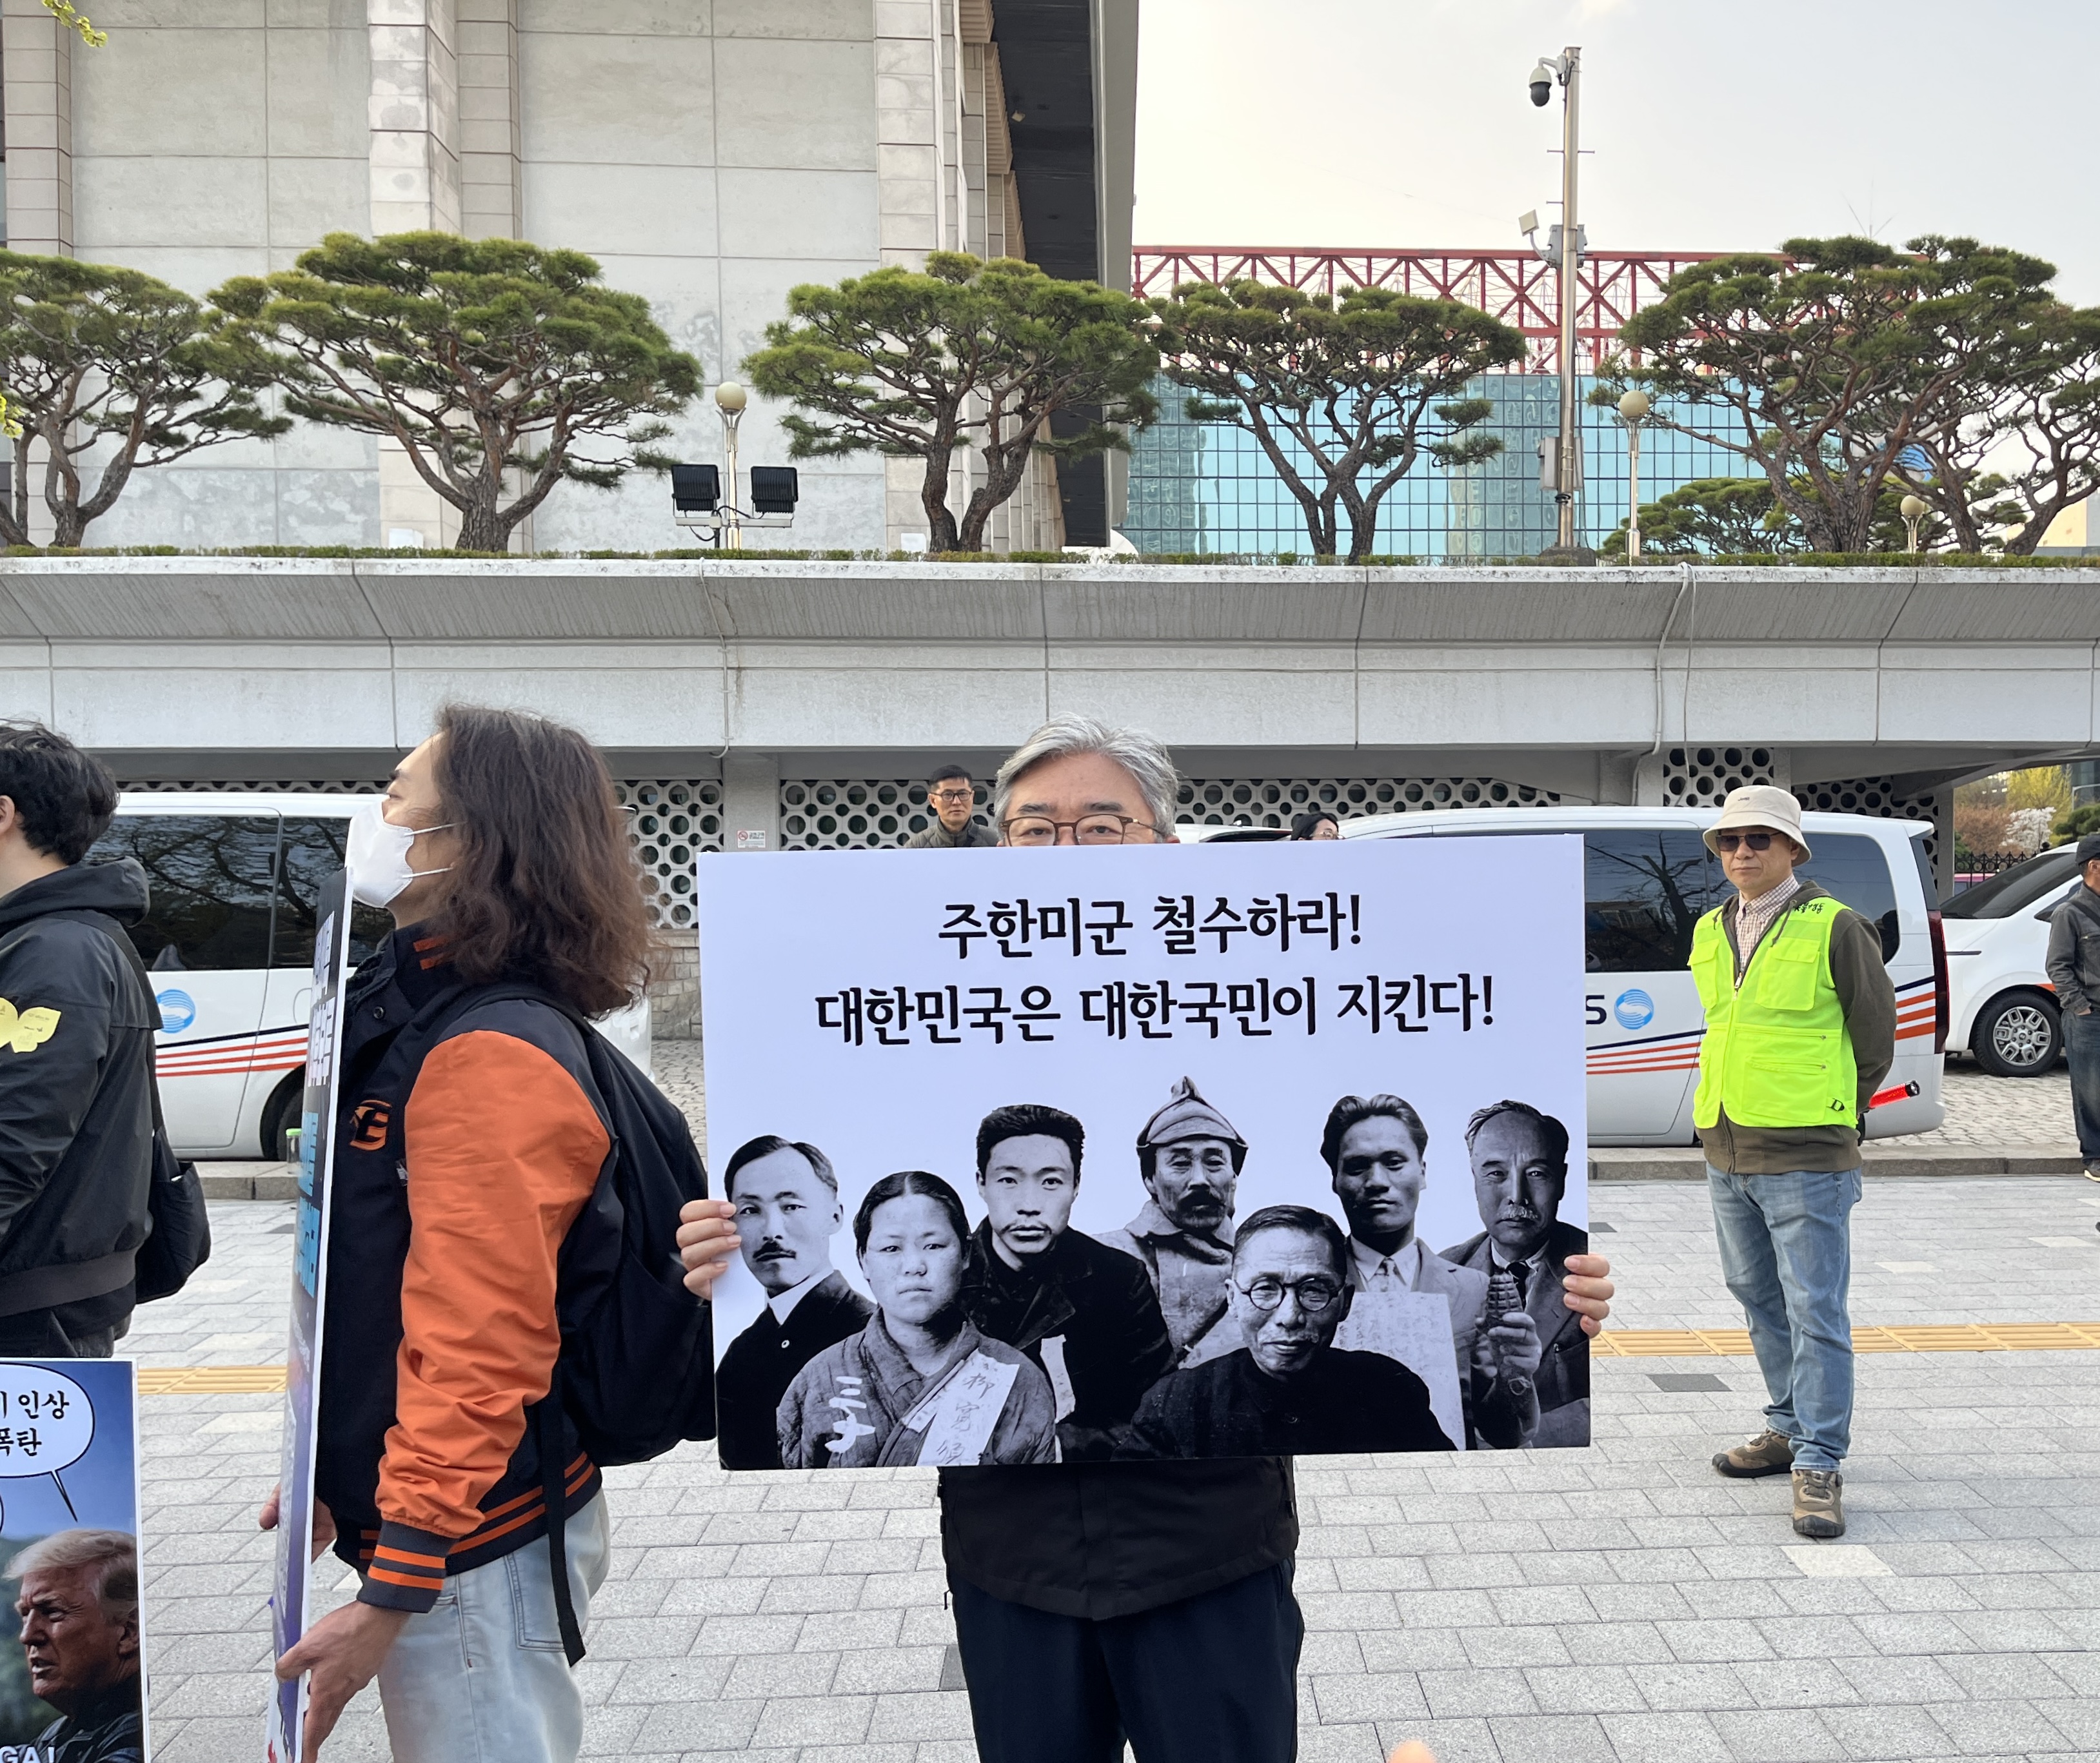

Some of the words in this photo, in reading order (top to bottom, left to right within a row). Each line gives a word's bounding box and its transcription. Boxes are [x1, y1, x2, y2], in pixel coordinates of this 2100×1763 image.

[938, 898, 1133, 960] 주한미군
[1153, 892, 1361, 955] 철수하라!
[815, 985, 1061, 1047] 대한민국은
[1079, 976, 1316, 1040] 대한국민이
[1337, 973, 1493, 1034] 지킨다!
[18, 1390, 70, 1420] 인상
